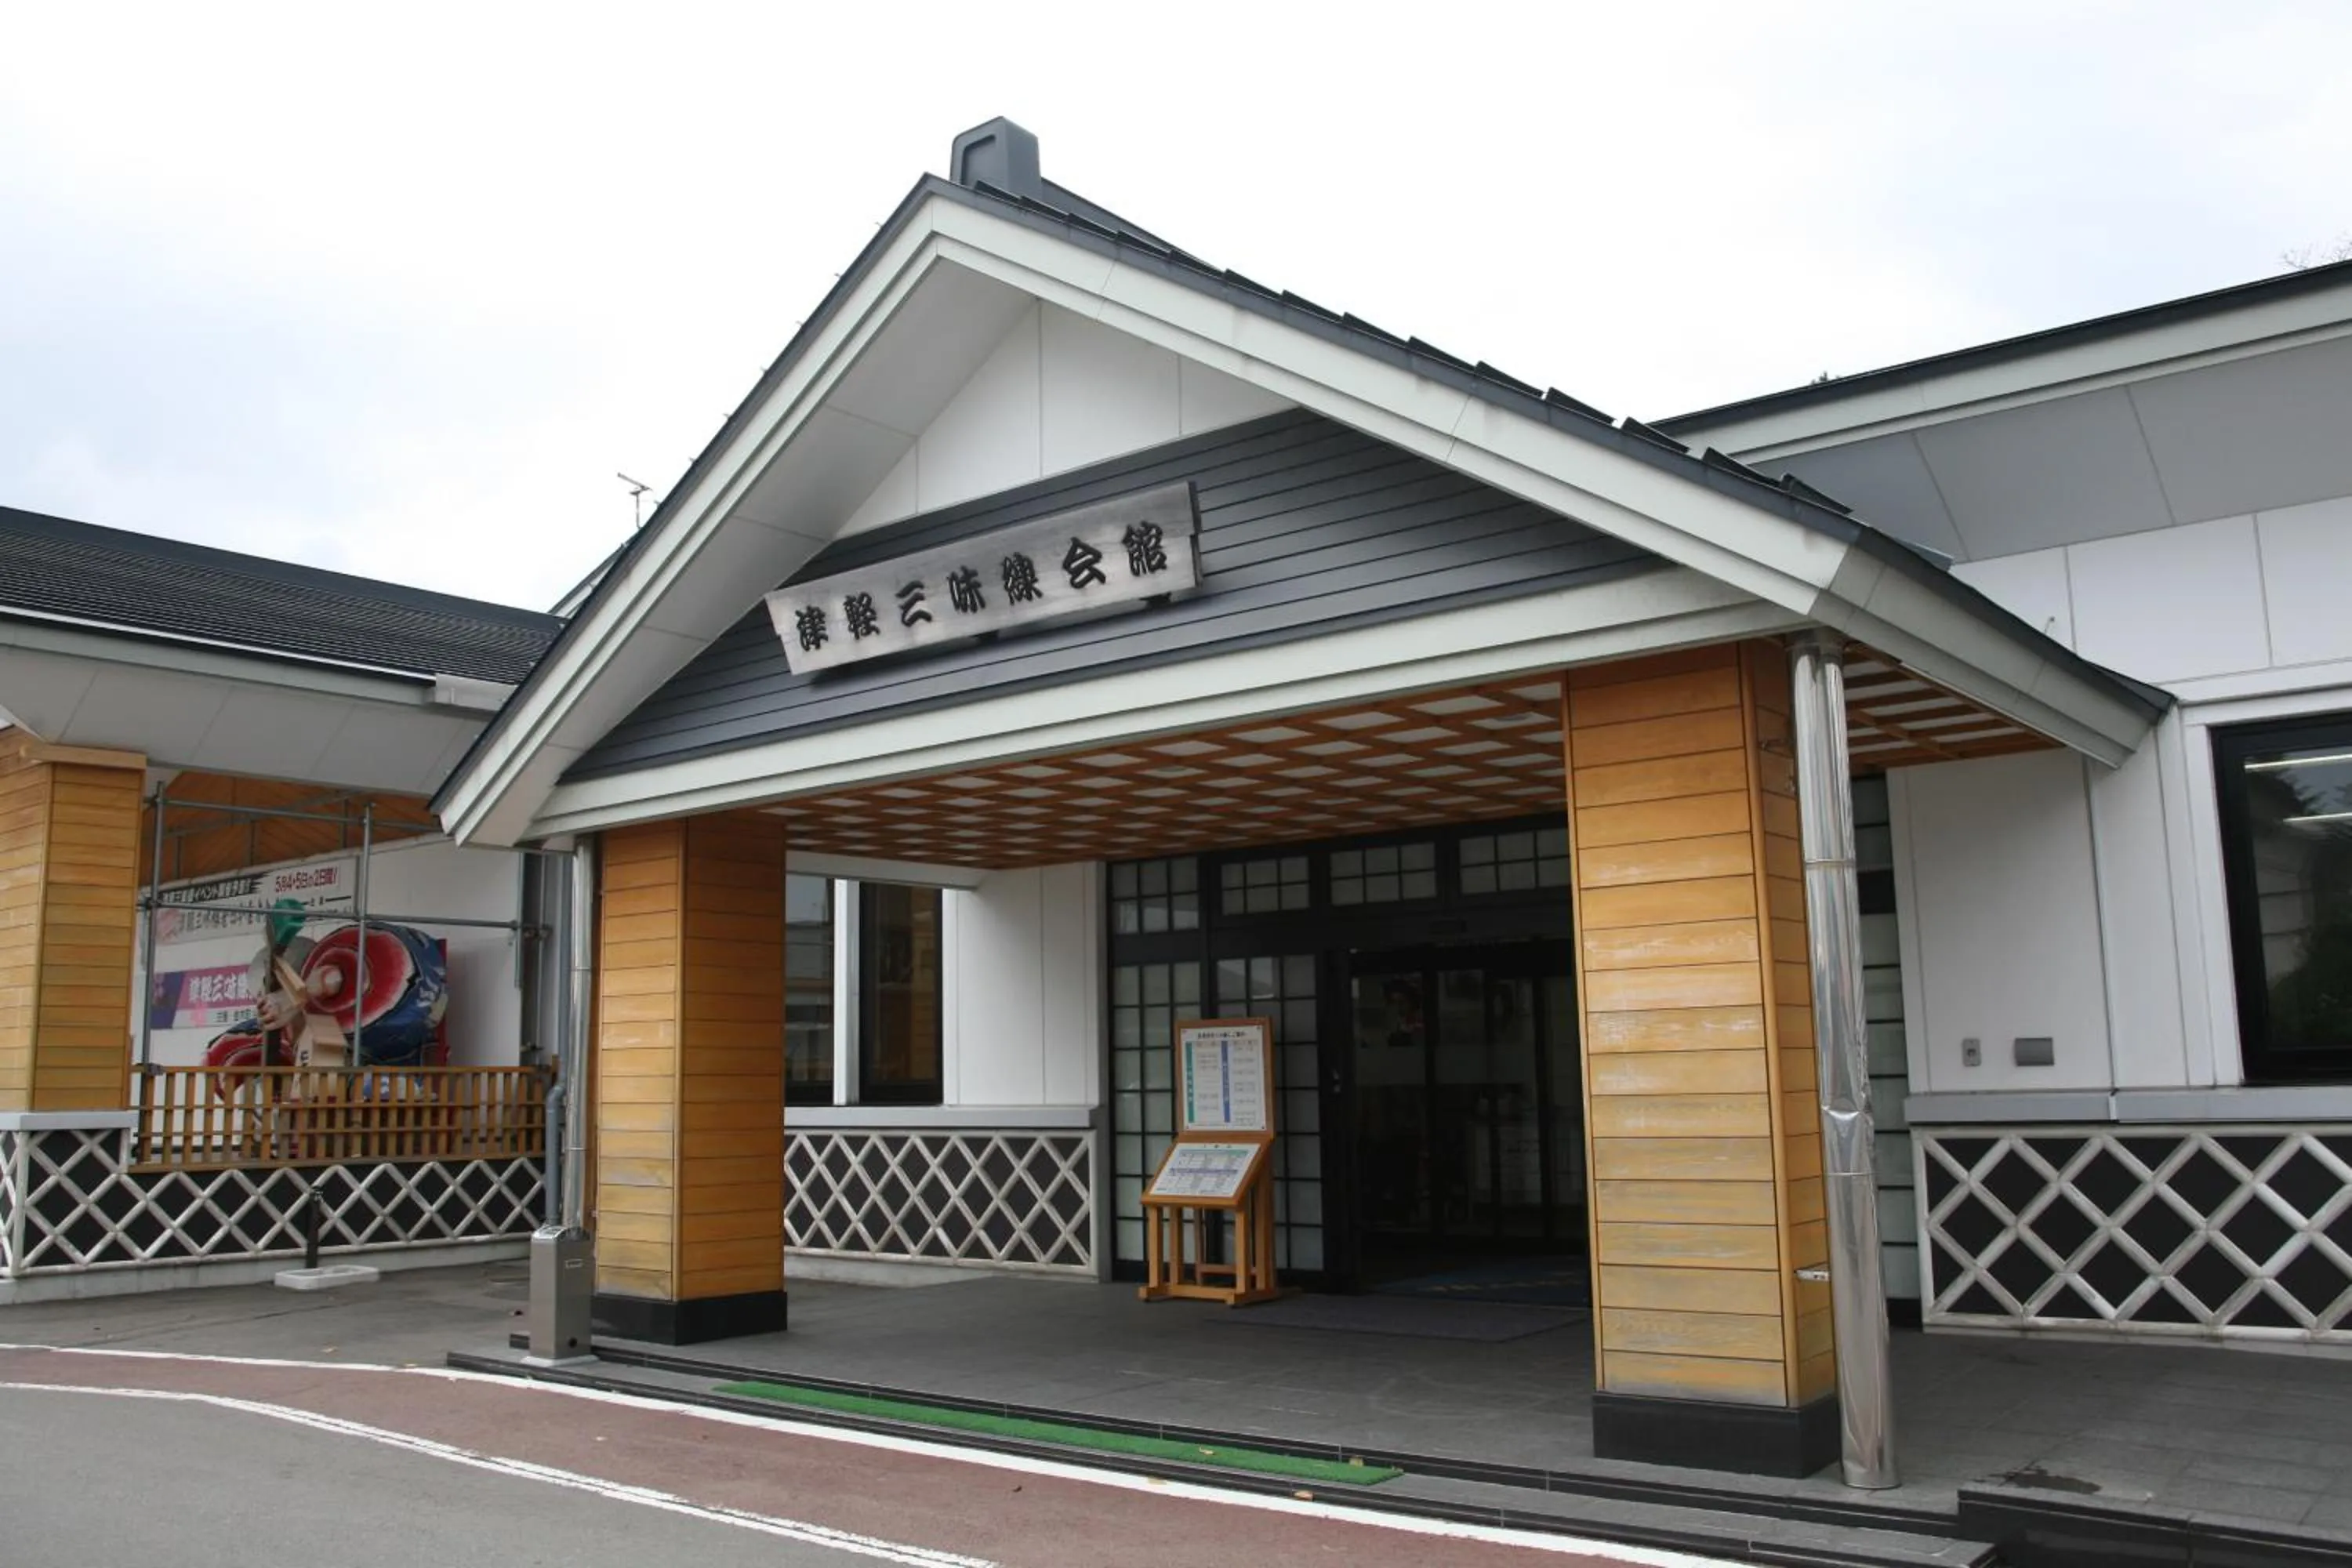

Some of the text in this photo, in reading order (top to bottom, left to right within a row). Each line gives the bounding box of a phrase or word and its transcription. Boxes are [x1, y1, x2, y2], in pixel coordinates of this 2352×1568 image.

[796, 521, 1167, 652] 津軽三味線会館
